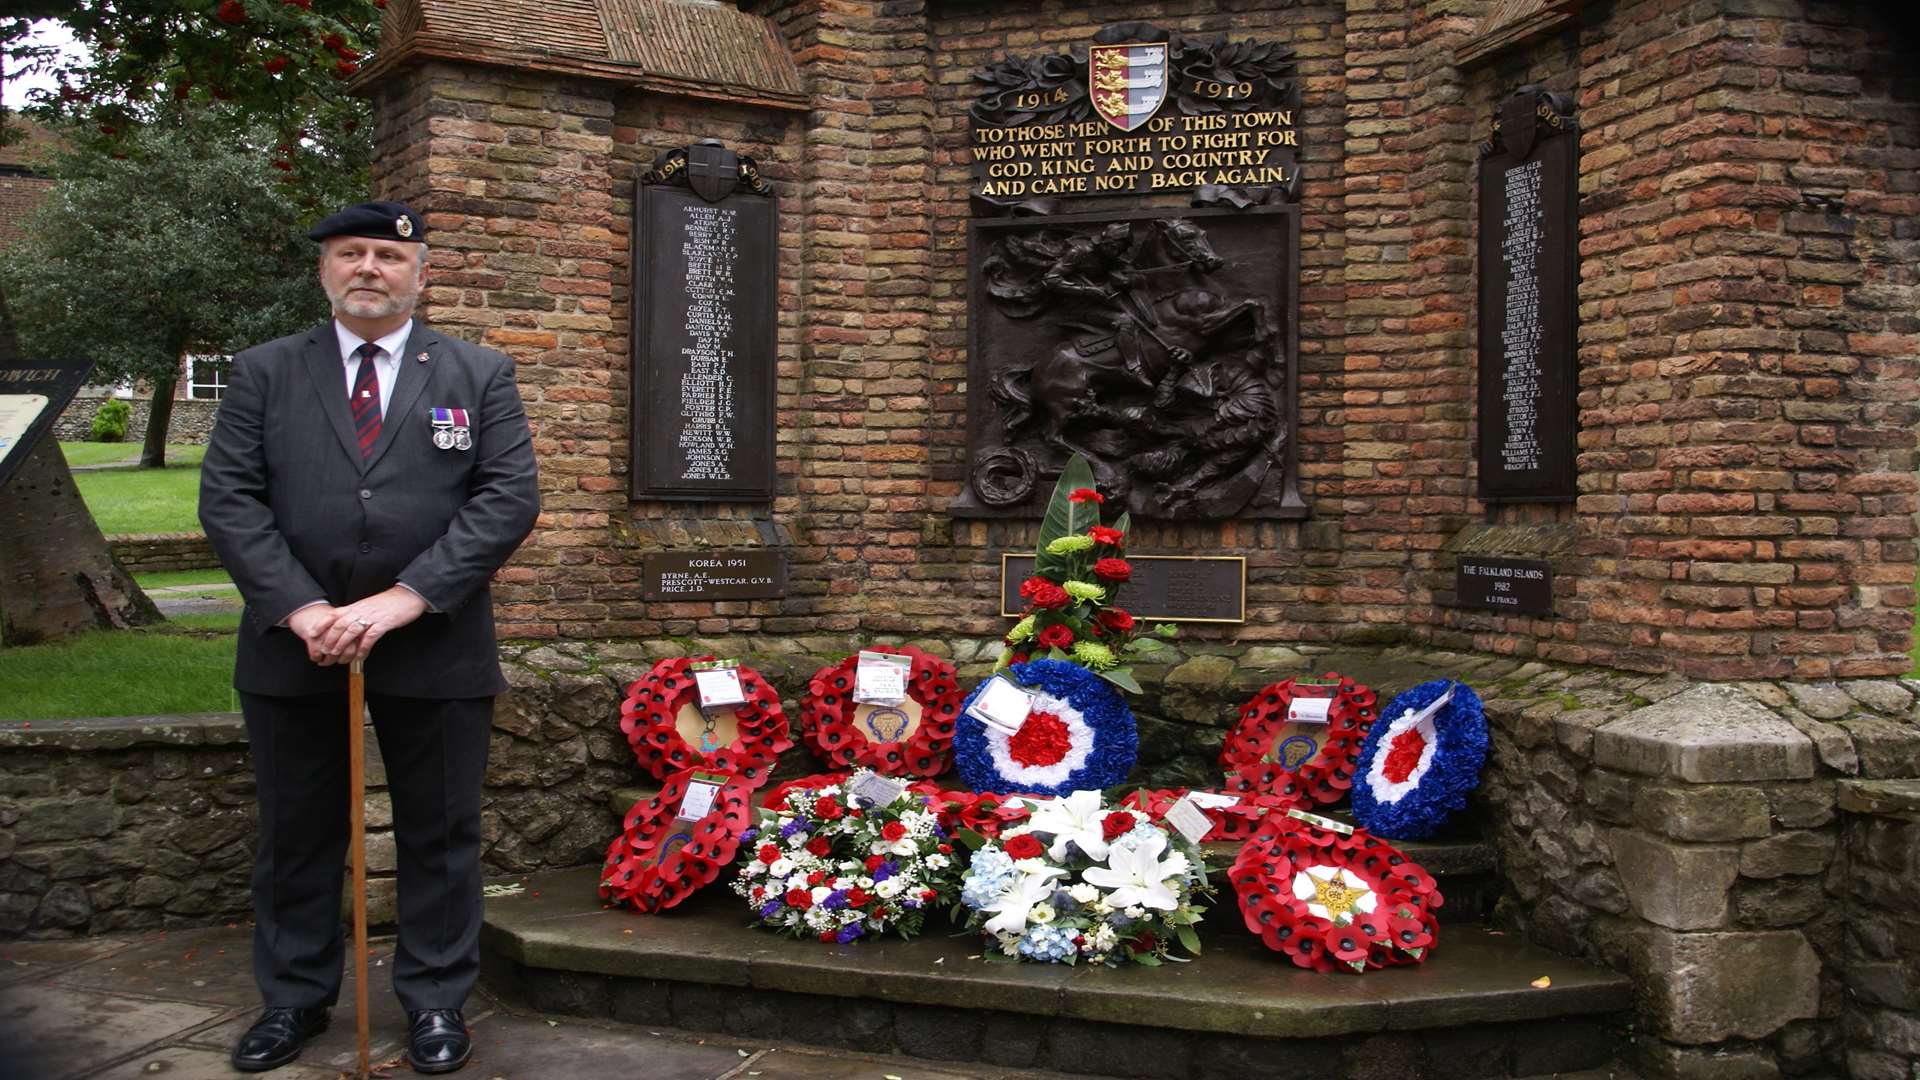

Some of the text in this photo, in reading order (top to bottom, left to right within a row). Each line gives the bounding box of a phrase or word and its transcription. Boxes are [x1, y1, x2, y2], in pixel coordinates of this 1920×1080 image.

[1016, 88, 1070, 109] 1914
[1192, 81, 1253, 100] 1919
[977, 111, 1292, 142] TO THOSE MEN OF THIS TOWN
[973, 130, 1298, 161] WHO WENT FORTH TO FIGHT FOR
[1042, 159, 1096, 175] KING
[1107, 155, 1154, 172] AND
[1162, 150, 1269, 169] COUNTRY
[740, 164, 762, 190] 1919
[981, 167, 1292, 196] AND CAME NOT BACK AGAIN.
[690, 212, 715, 220] ALLEN
[687, 311, 714, 319] CURTIS
[682, 348, 717, 356] DRAYSON
[689, 560, 723, 568] KOREA
[1464, 566, 1544, 579] THE FALKLAND ISLANDS
